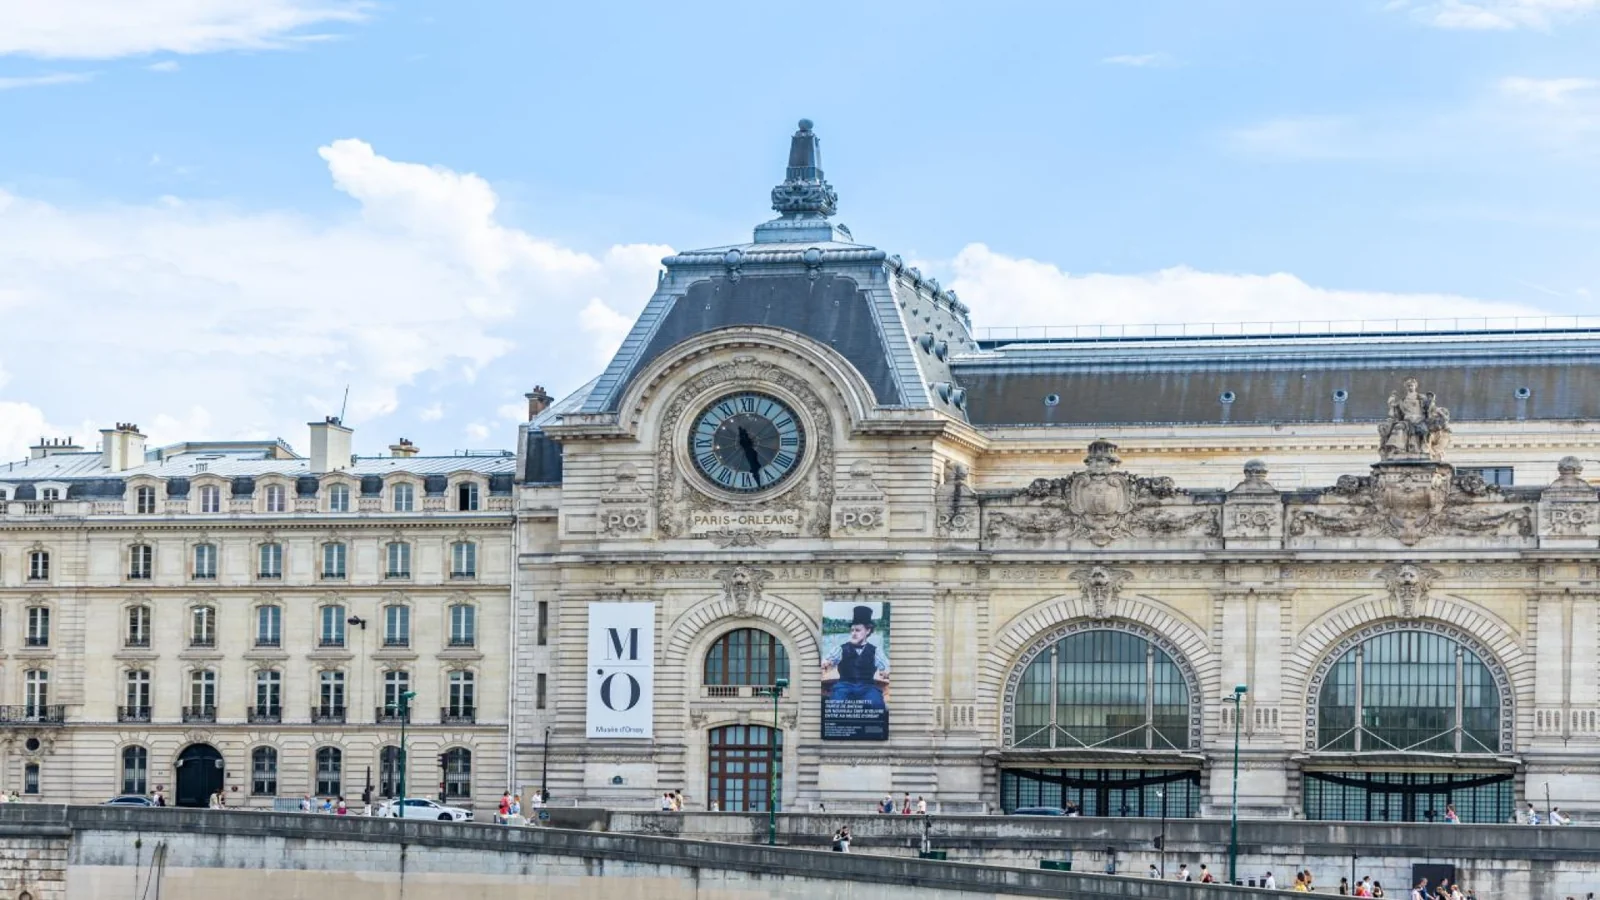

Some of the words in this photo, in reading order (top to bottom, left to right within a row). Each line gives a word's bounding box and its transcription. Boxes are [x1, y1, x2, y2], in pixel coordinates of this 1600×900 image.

[740, 397, 755, 413] XII
[609, 514, 638, 529] PO
[694, 515, 795, 525] PARIS-ORLEANS
[843, 512, 874, 527] PO
[936, 513, 967, 528] PO
[1236, 511, 1267, 526] PO
[1550, 509, 1584, 525] PO
[601, 627, 642, 661] M
